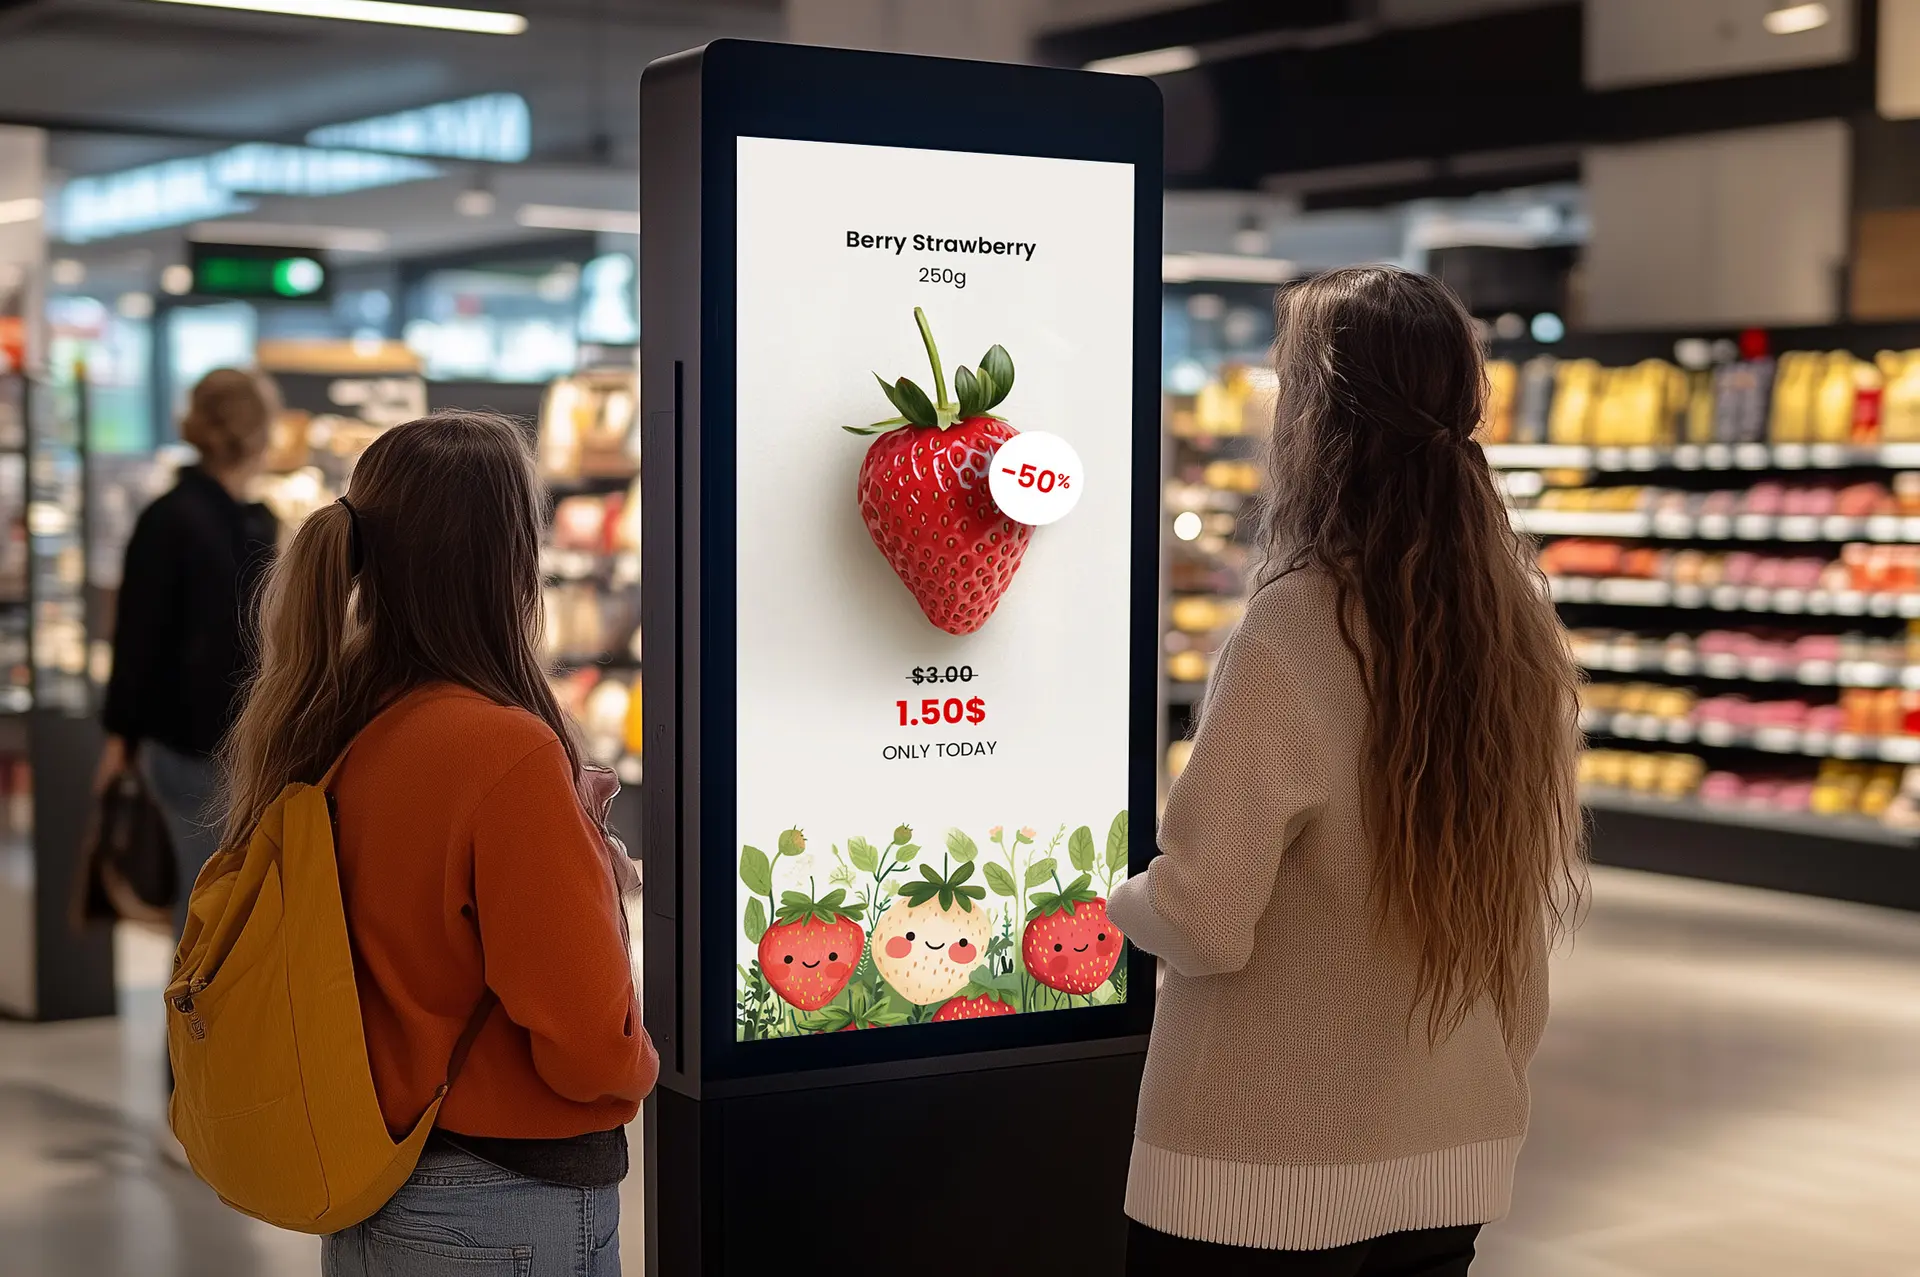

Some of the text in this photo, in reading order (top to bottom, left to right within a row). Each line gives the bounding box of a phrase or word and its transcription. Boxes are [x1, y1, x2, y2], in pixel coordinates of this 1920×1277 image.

[846, 230, 1037, 262] Berry Strawberry
[918, 267, 967, 290] 250g
[1001, 463, 1071, 494] -50%
[911, 665, 974, 686] $3.00
[895, 695, 986, 727] 1.50$
[882, 740, 998, 761] ONLY TODAY
